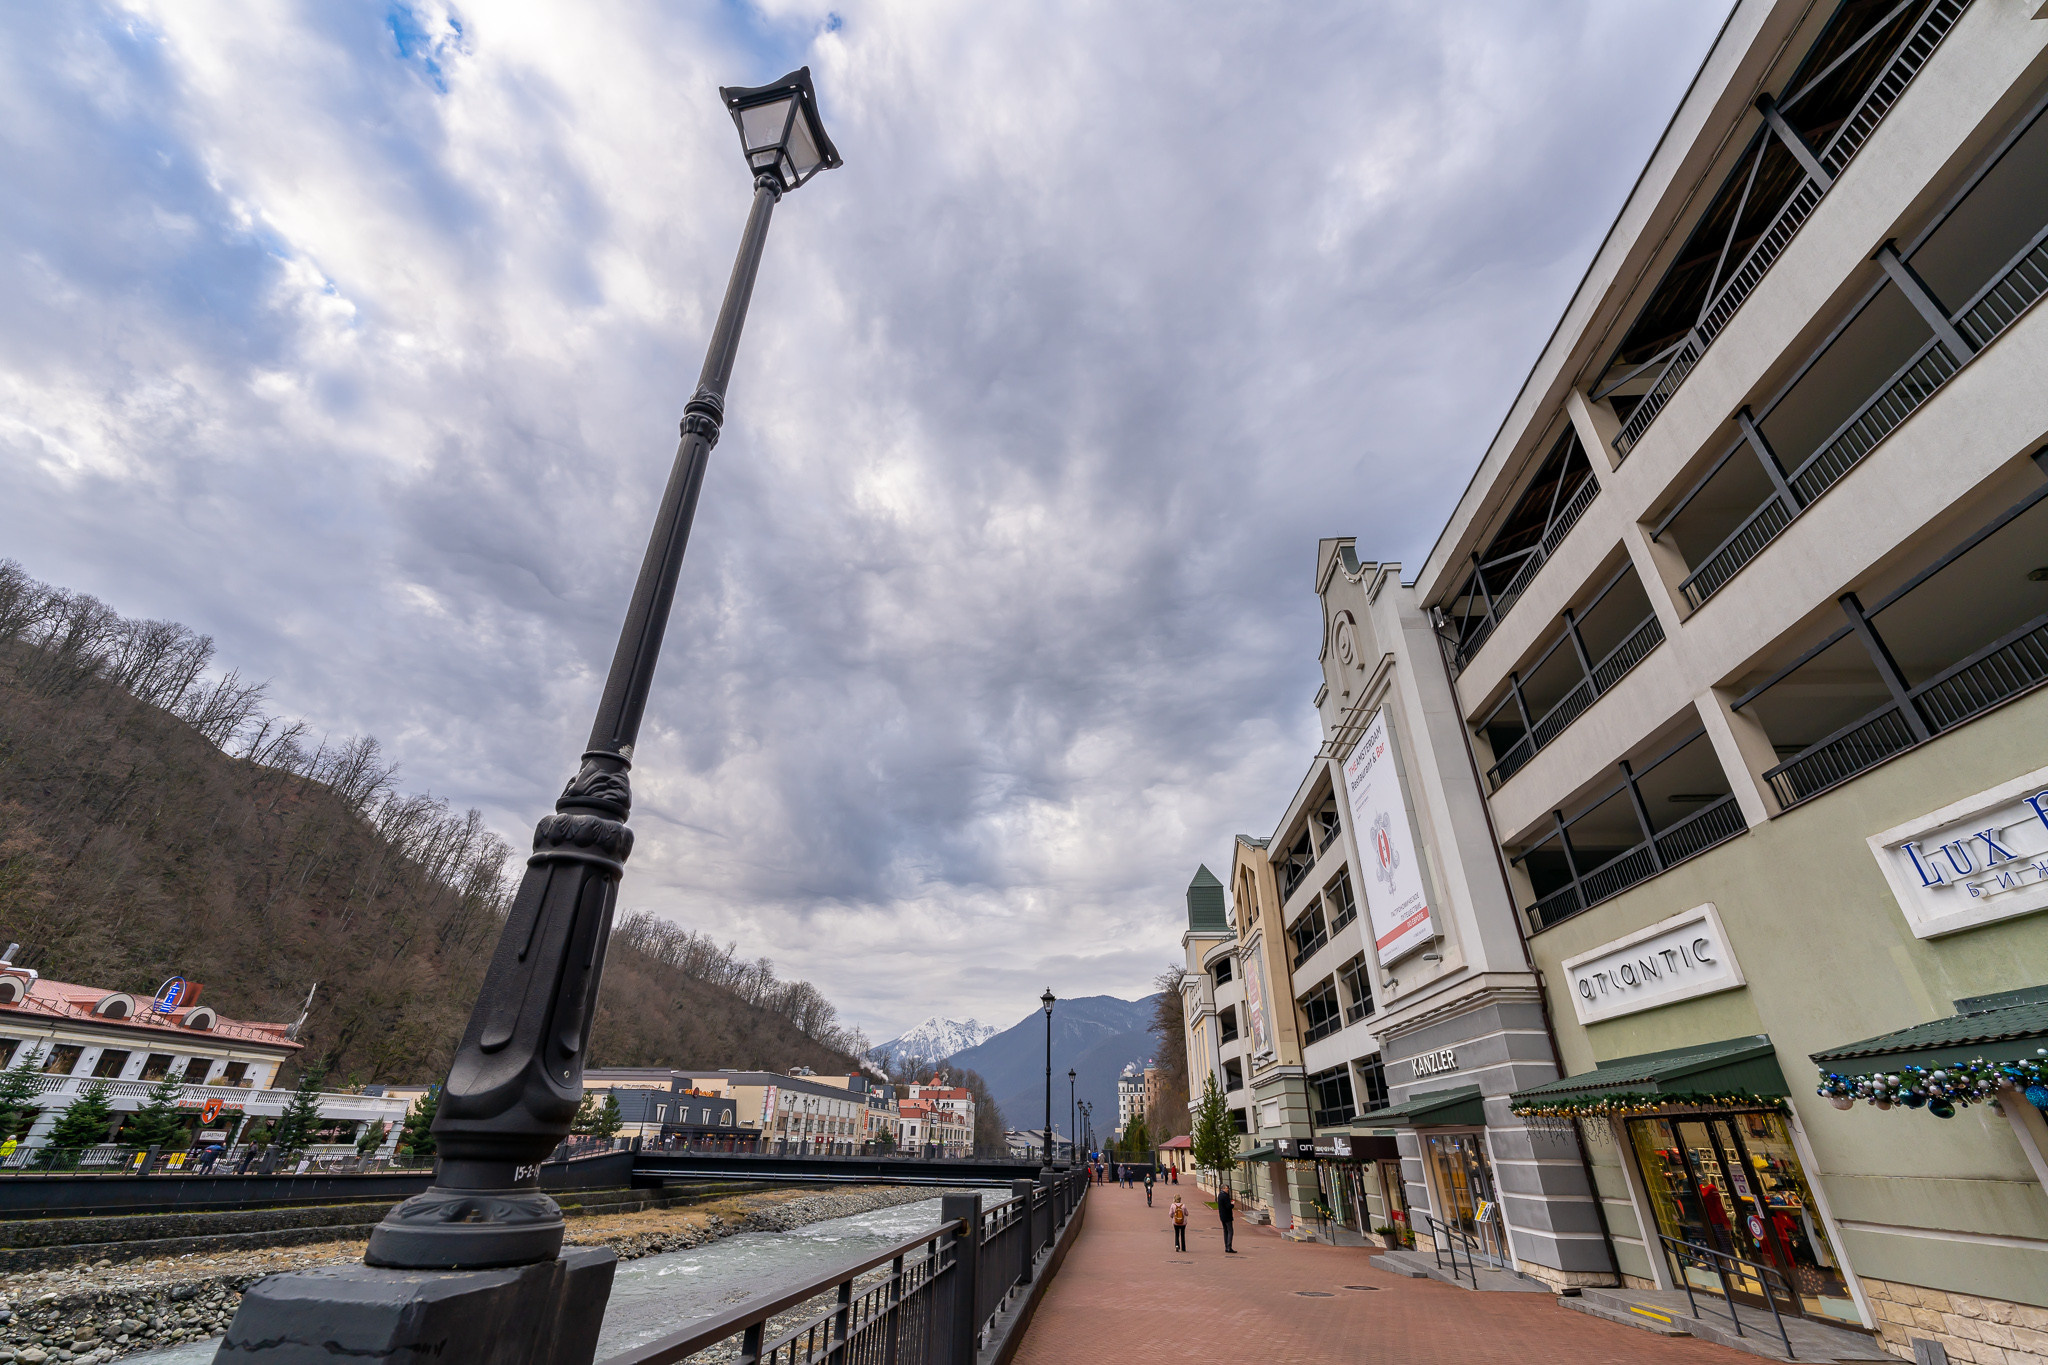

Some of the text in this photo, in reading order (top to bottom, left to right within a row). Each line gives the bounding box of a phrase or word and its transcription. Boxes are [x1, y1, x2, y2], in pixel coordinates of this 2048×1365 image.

[1351, 758, 1372, 792] Restaurant
[1376, 742, 1384, 758] Bar
[1902, 828, 2018, 887] LUX
[1411, 912, 1425, 926] ЕВРОПЕ
[1411, 1049, 1457, 1077] KANZLER
